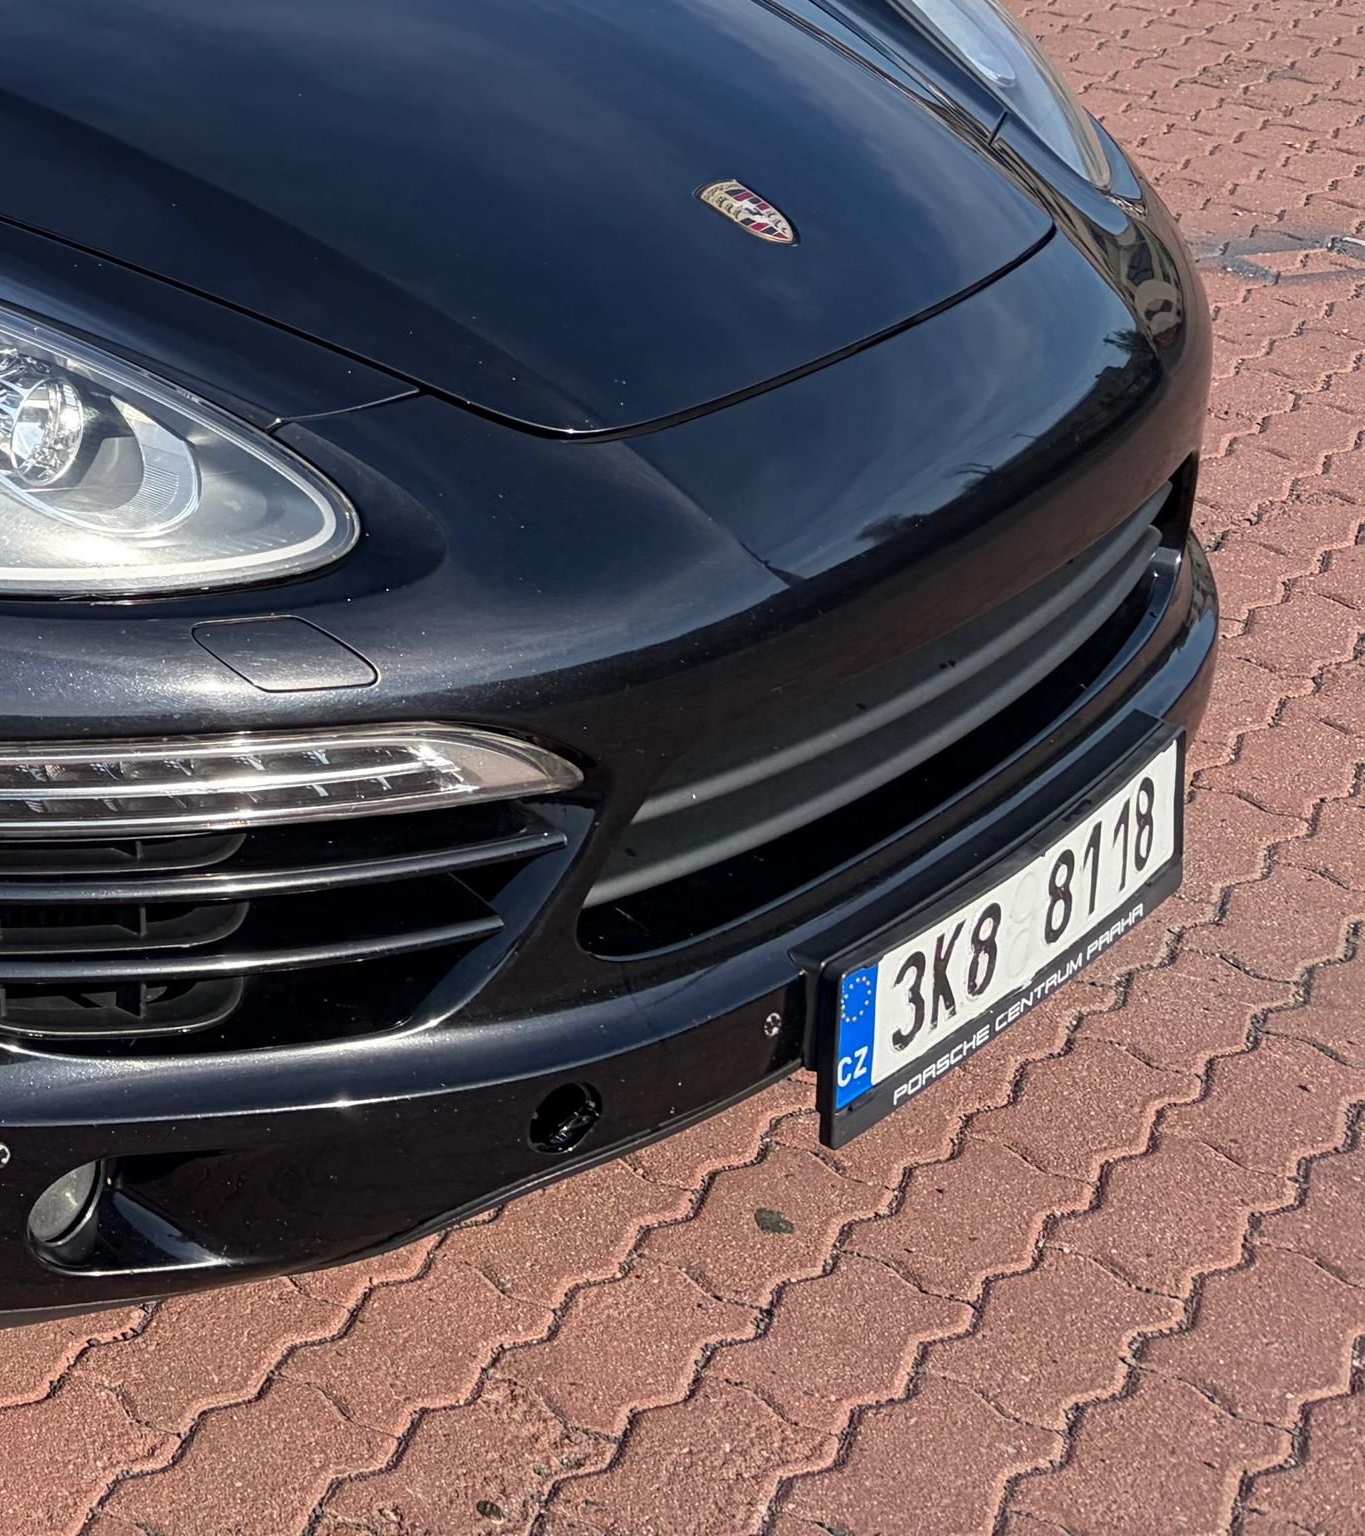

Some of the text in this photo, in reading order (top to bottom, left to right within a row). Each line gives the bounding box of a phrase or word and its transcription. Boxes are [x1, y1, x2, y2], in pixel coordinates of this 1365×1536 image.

[891, 775, 1156, 1052] 3K8 8118
[892, 902, 1144, 1106] PORSCHE CENTRUM PRAHA
[836, 1045, 870, 1088] CZ
